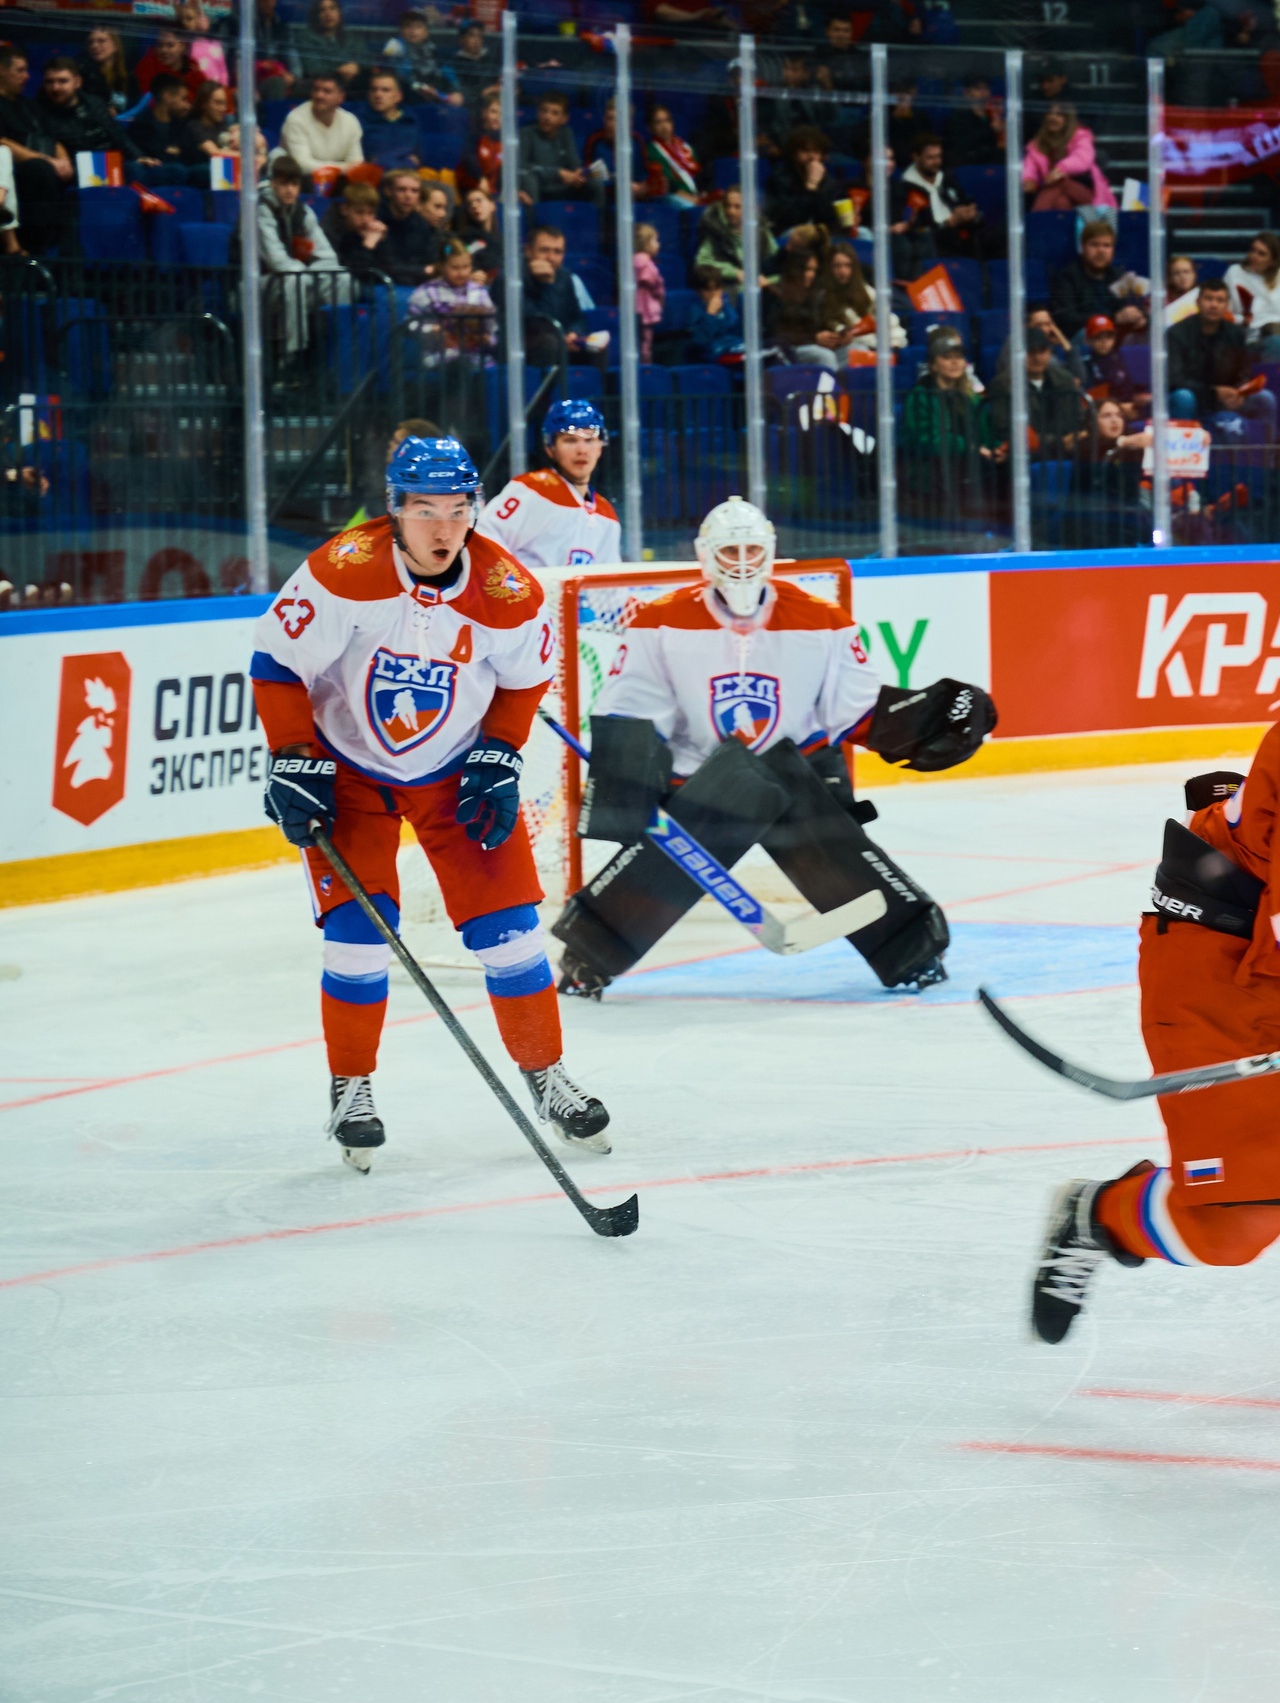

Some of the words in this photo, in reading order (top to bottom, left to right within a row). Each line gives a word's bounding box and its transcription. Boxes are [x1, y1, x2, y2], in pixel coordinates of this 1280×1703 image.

[1043, 2, 1067, 24] 12
[1089, 63, 1107, 86] 11
[496, 497, 520, 520] 9
[375, 650, 453, 687] СХЛ
[712, 674, 776, 702] СХЛ
[154, 672, 258, 741] СПО
[150, 745, 272, 796] ЭКСПРЕ
[272, 757, 337, 776] BAUE
[664, 835, 758, 919] BAUER
[861, 850, 918, 903] BAUER
